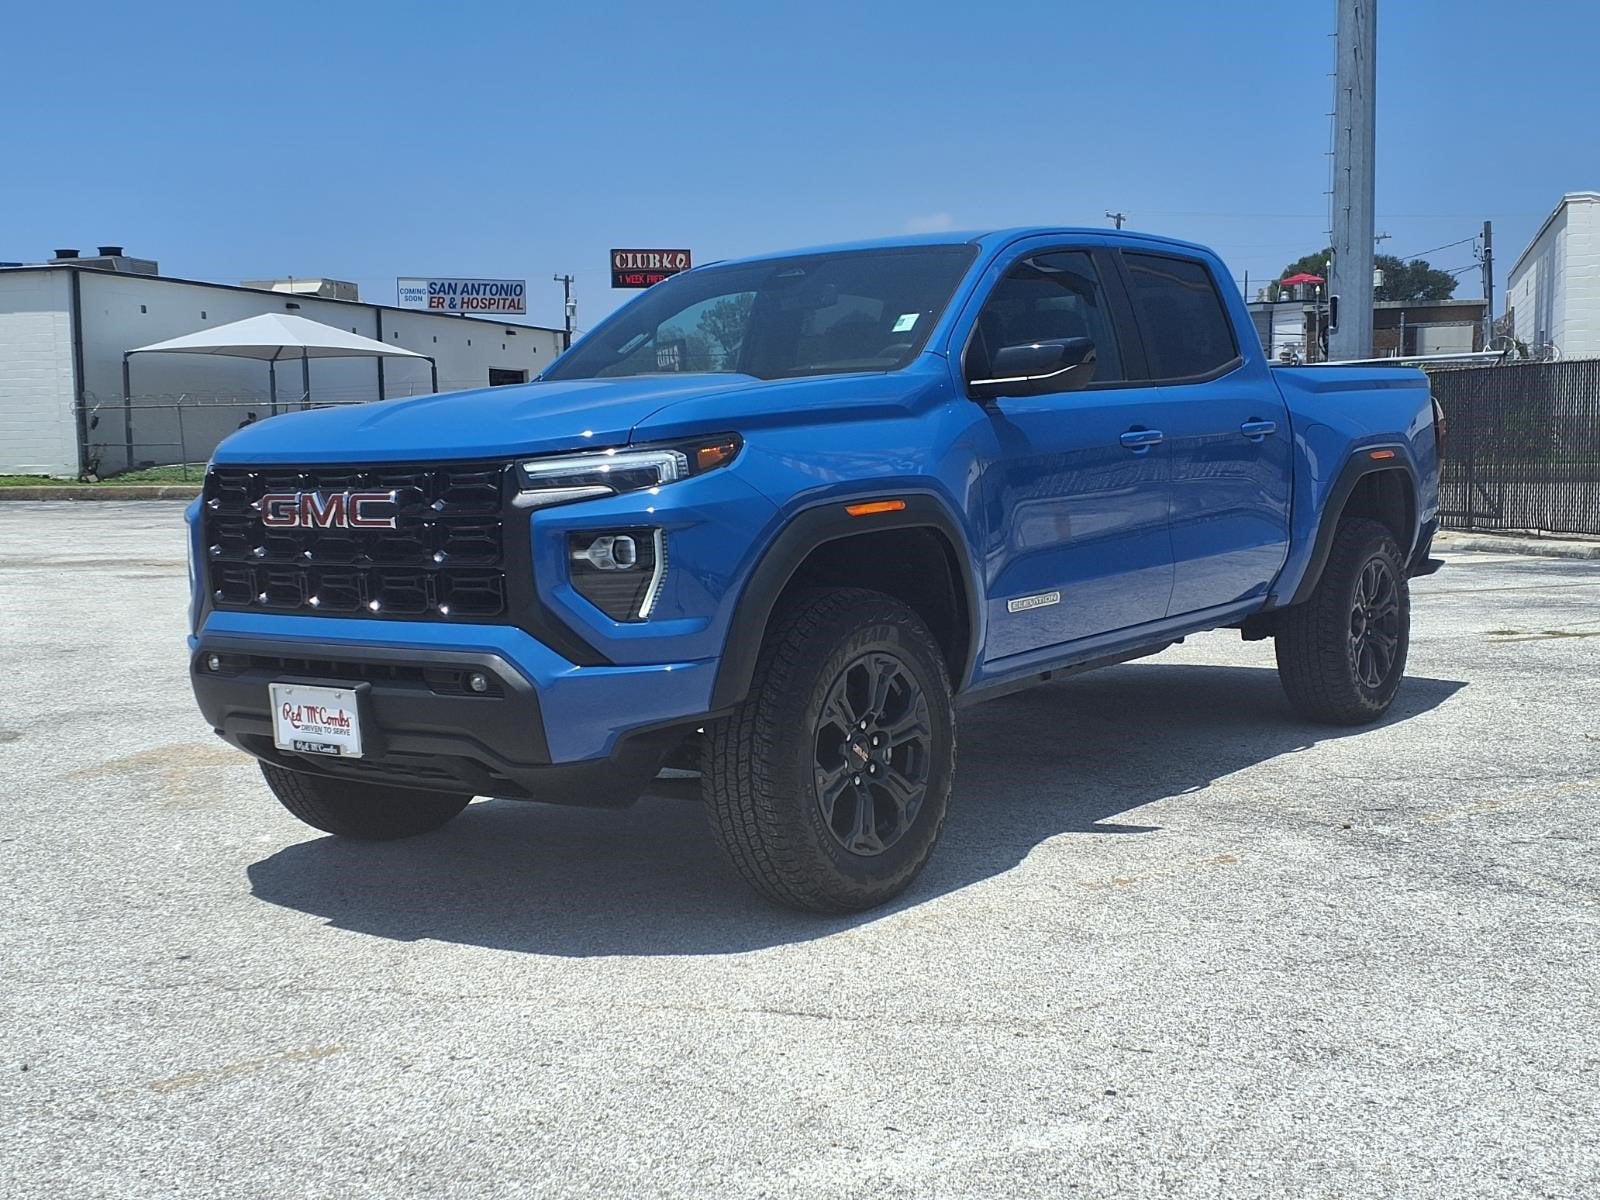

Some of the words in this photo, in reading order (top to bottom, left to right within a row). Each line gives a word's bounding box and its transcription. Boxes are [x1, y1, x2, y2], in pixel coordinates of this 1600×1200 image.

[615, 252, 660, 268] CLUB
[625, 274, 645, 283] WEEK
[428, 282, 457, 296] SAN
[460, 283, 524, 297] ANTONIO
[428, 296, 446, 309] ER
[448, 297, 457, 309] &
[460, 297, 524, 310] HOSPITAL
[260, 490, 397, 530] GMC
[1011, 594, 1058, 609] ELEVATION
[283, 702, 302, 729] Red
[301, 725, 323, 733] DRIVEN
[333, 728, 350, 736] SERVE
